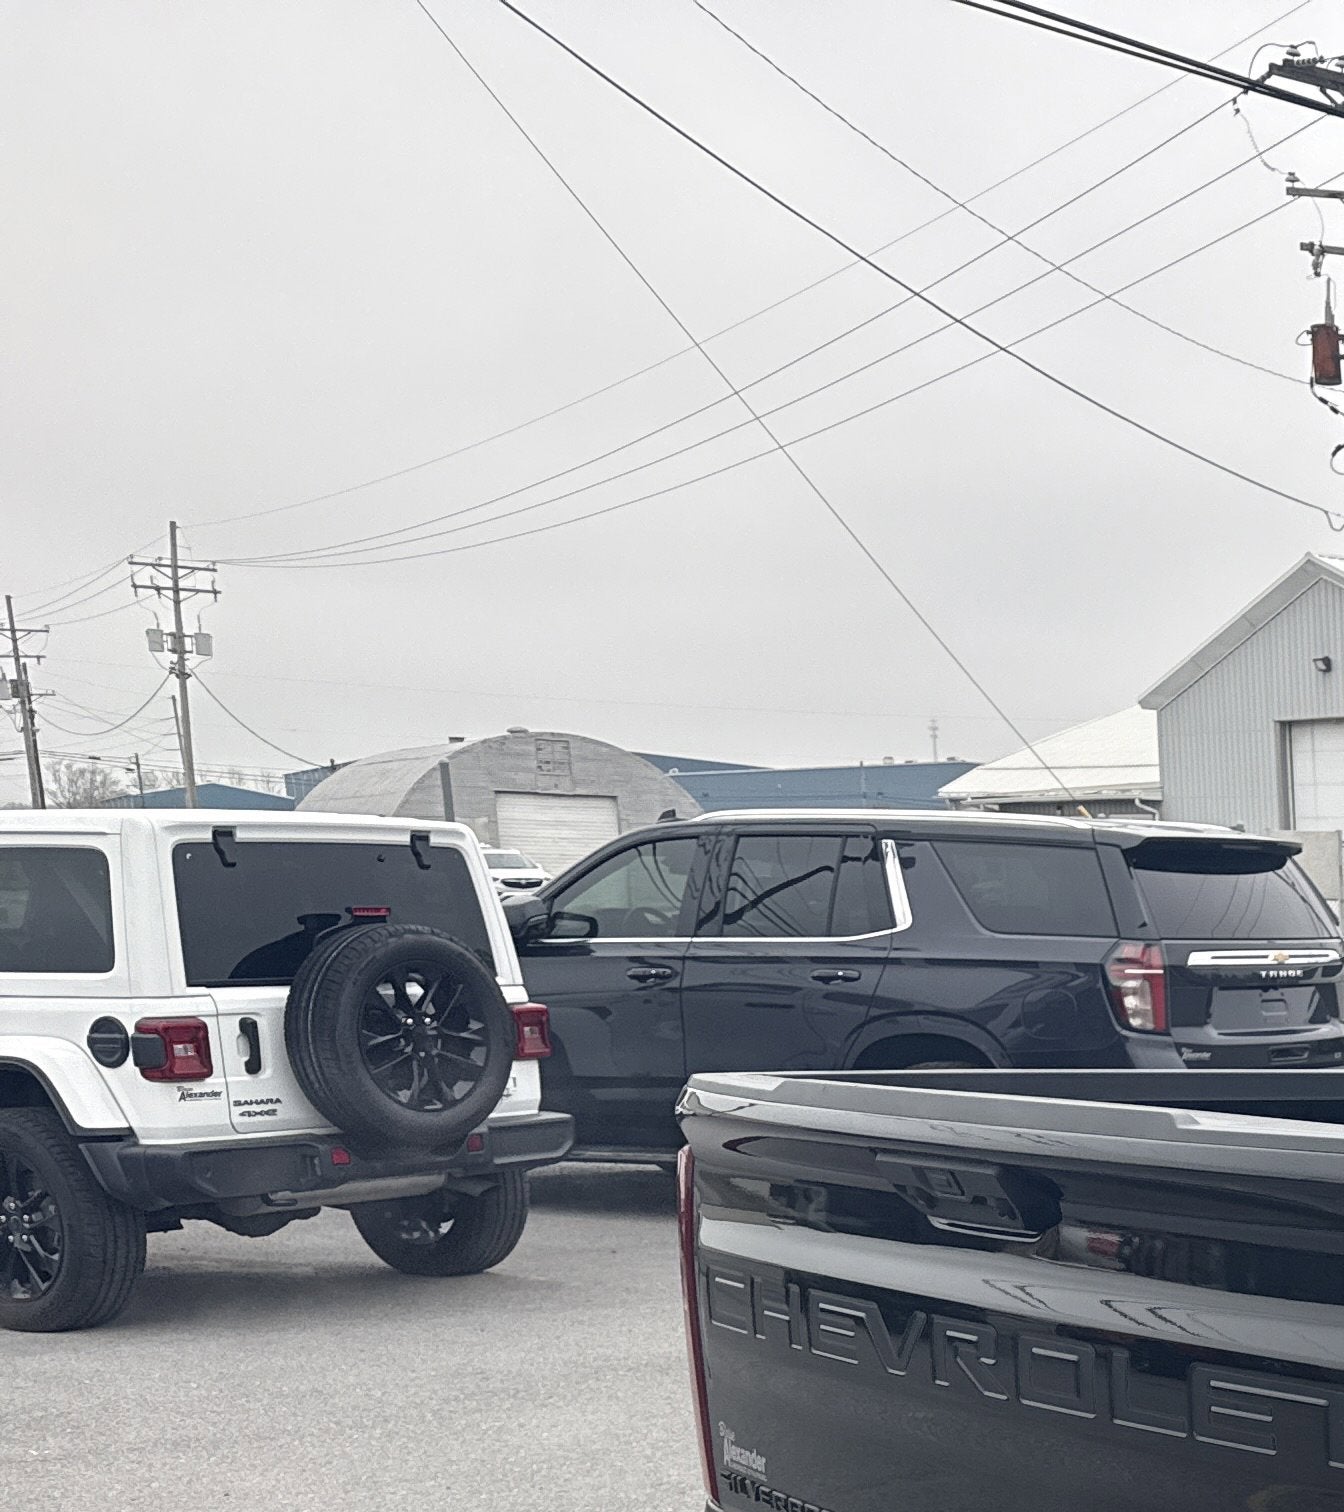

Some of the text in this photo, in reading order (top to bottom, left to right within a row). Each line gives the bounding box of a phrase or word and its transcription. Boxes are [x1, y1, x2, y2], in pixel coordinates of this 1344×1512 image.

[1260, 970, 1303, 978] TAHOE
[232, 1098, 282, 1107] SAHARA
[724, 1437, 766, 1474] Alexander
